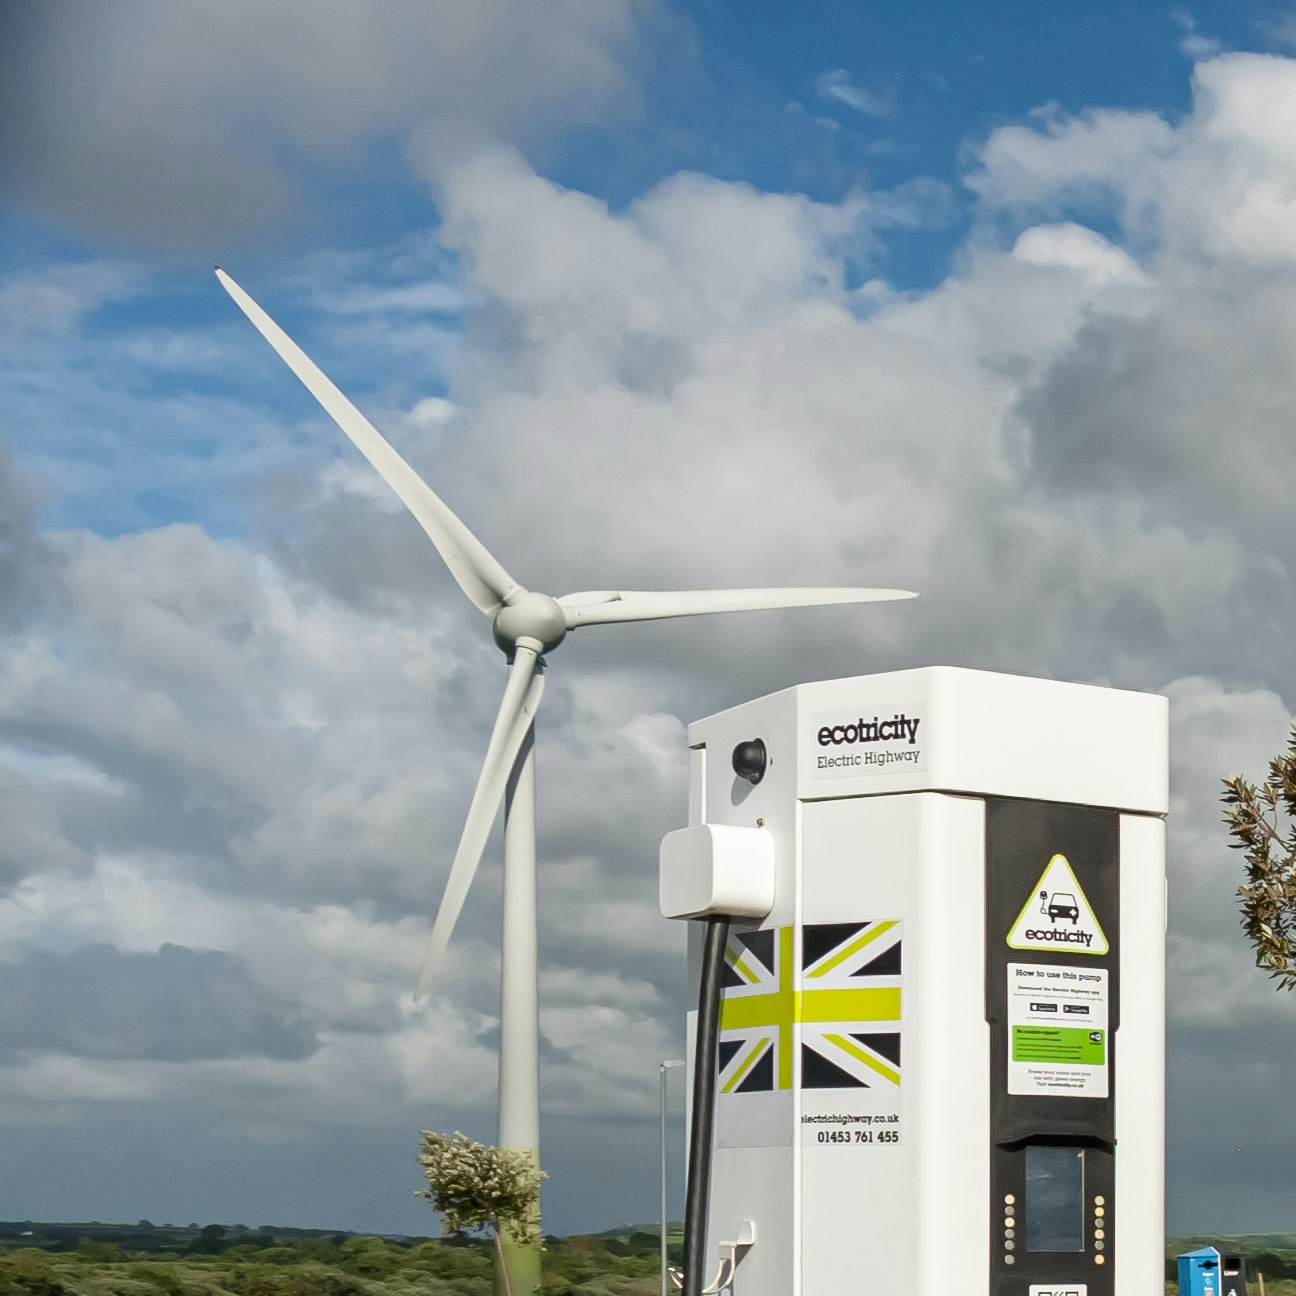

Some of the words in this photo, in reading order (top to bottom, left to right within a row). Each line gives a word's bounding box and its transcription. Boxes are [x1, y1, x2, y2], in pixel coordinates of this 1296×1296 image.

[817, 714, 920, 748] ecotricity
[817, 754, 862, 769] Electric
[865, 749, 920, 767] Highway
[1025, 928, 1093, 947] ecotricity
[1063, 972, 1077, 980] this
[1079, 974, 1101, 982] pump
[817, 1131, 851, 1143] 01453
[855, 1131, 873, 1143] 761
[877, 1131, 899, 1143] 455
